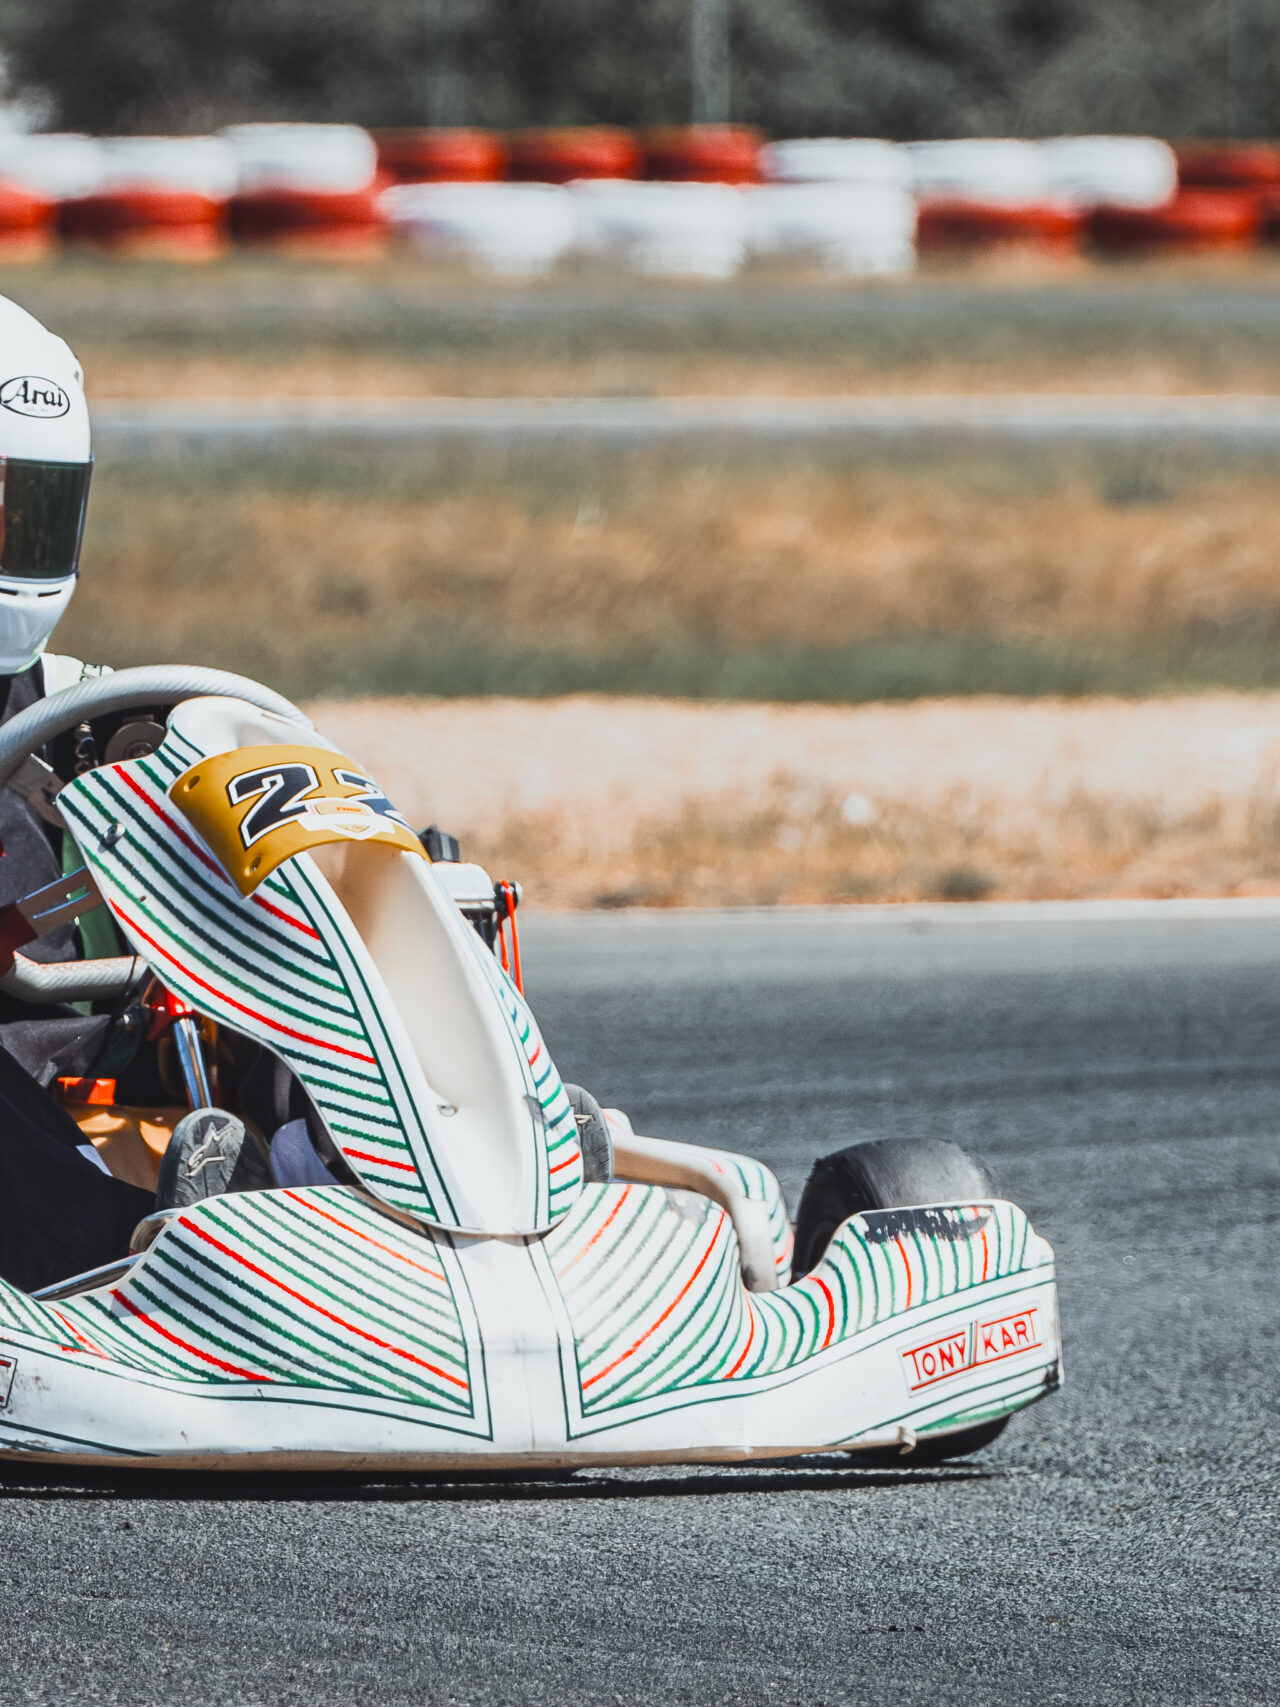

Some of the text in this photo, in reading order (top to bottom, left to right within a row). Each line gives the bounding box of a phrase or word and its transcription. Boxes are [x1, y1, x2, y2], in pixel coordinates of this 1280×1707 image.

[3, 380, 63, 408] Arai
[902, 1308, 1038, 1381] TONY KART
